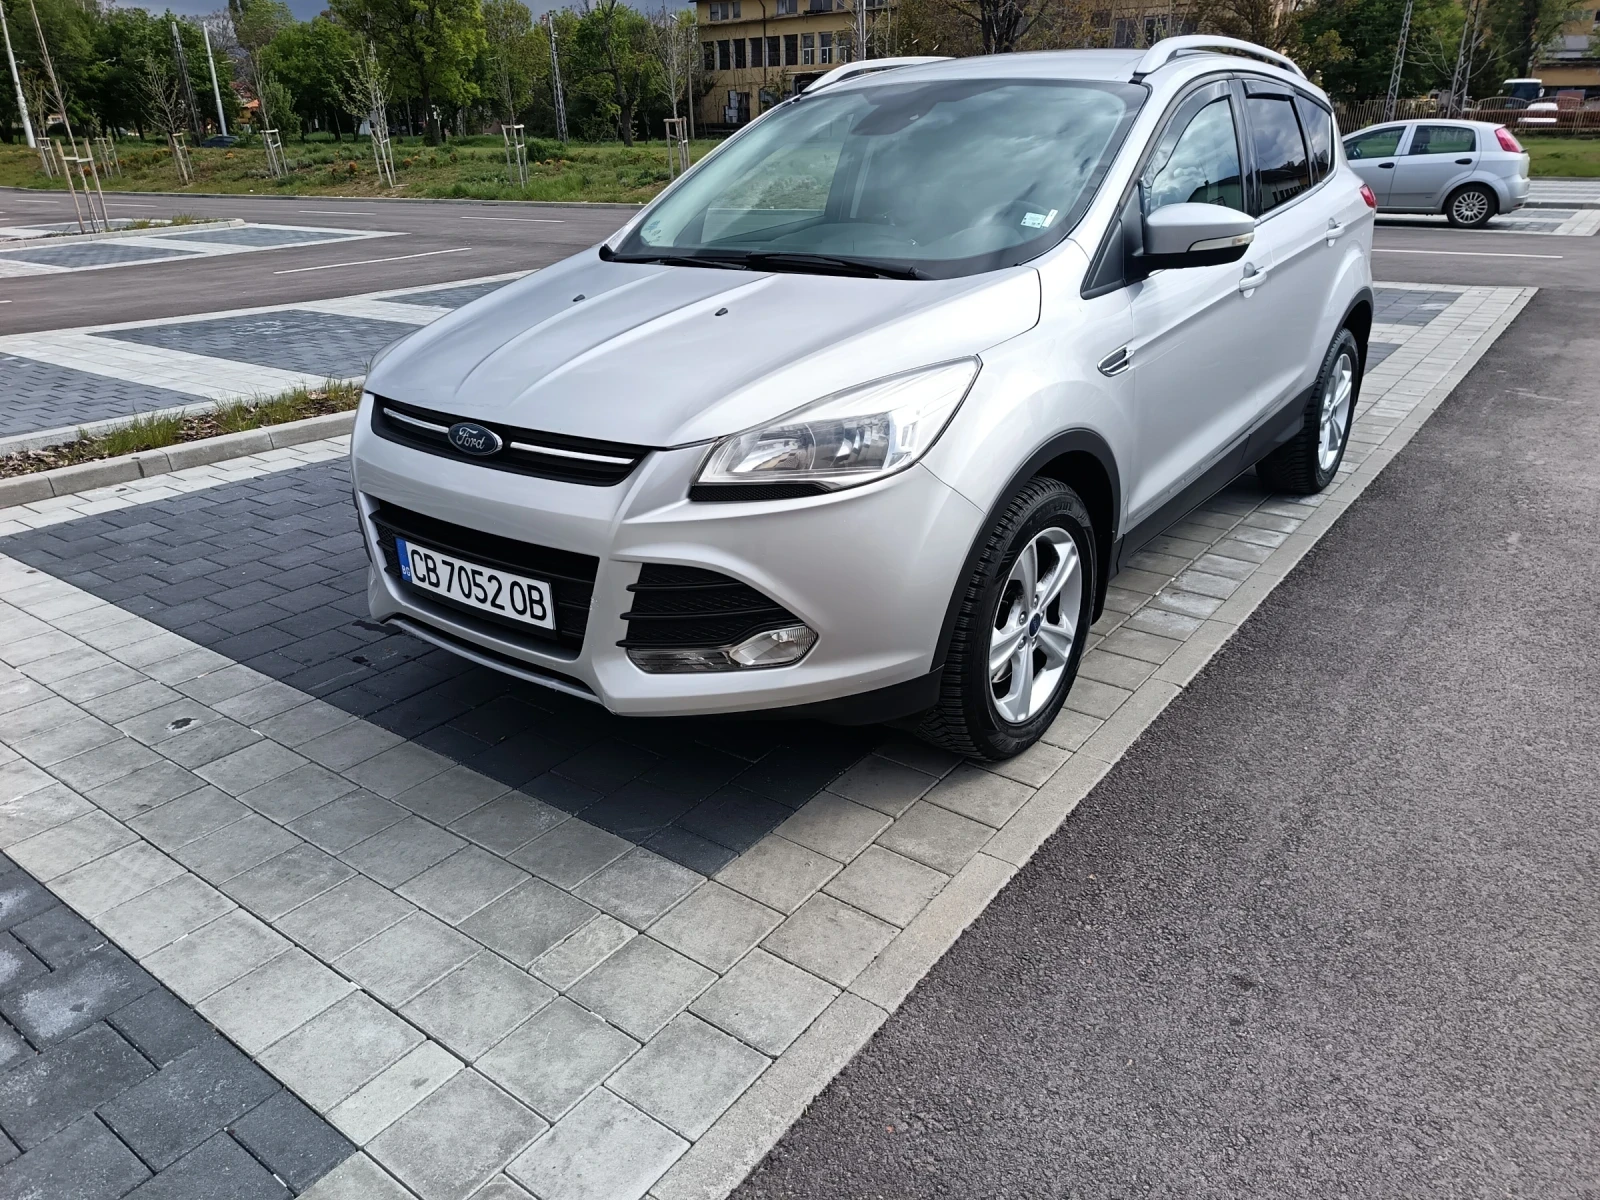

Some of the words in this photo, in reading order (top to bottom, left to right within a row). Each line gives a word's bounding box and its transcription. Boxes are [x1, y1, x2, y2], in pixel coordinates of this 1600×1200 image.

[456, 426, 486, 449] Ford
[401, 564, 411, 577] BG
[441, 559, 505, 611] 7052
